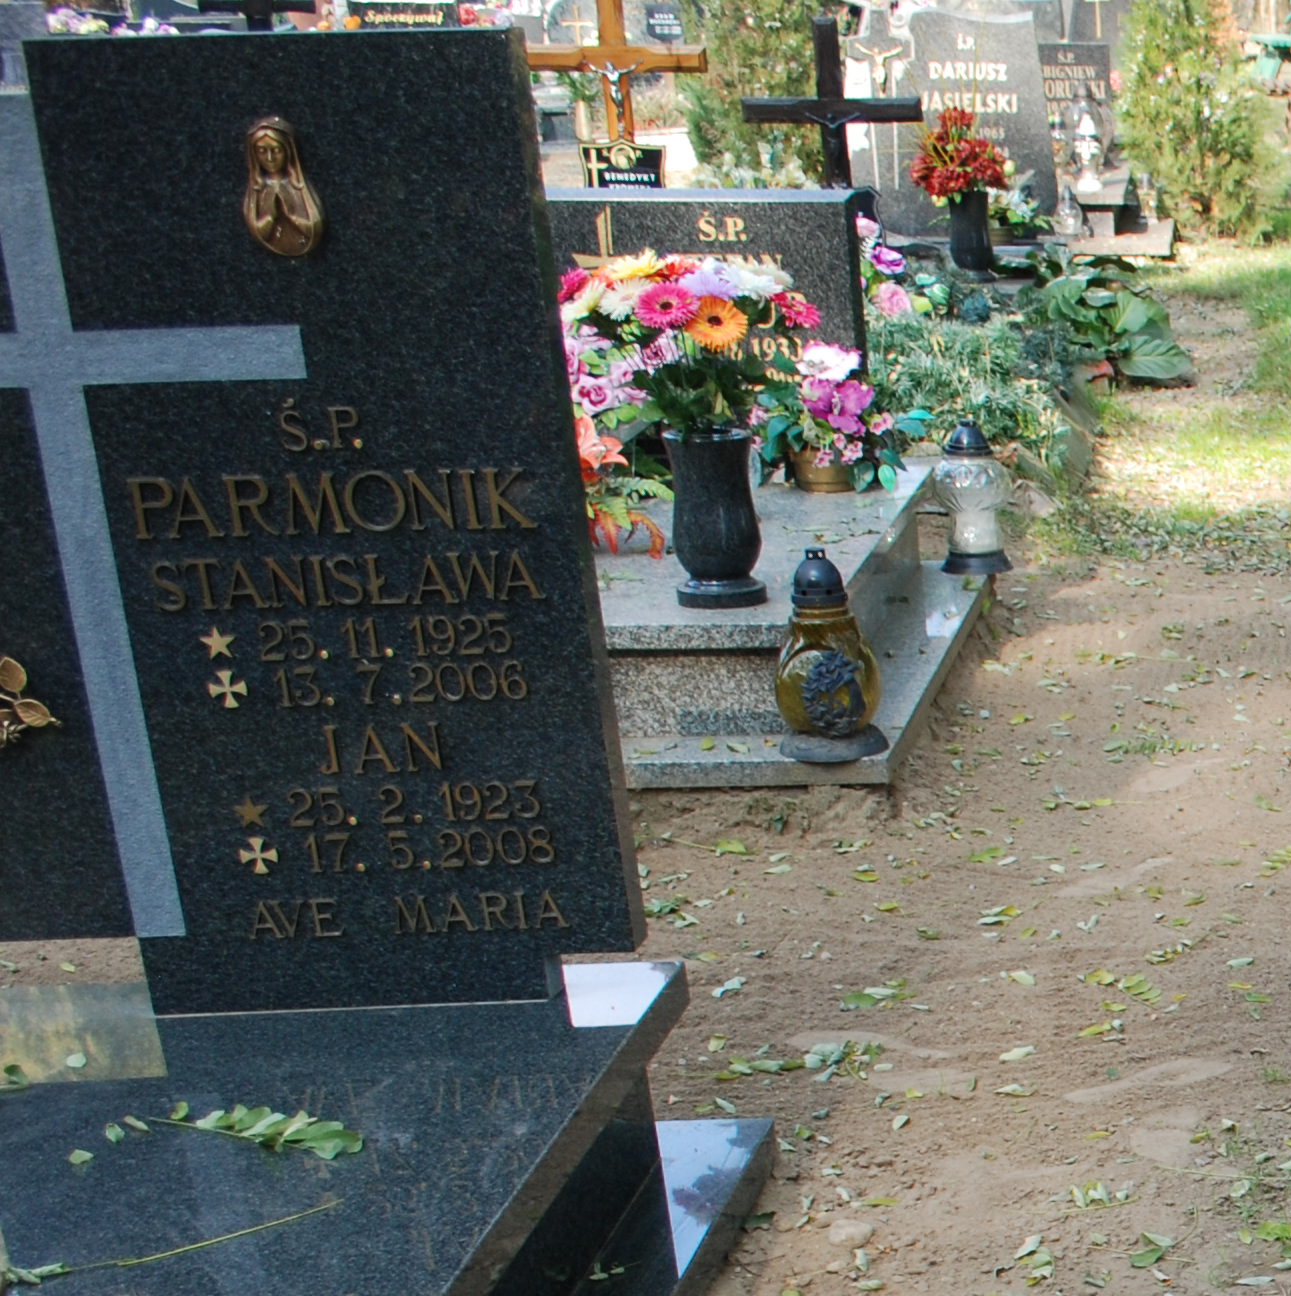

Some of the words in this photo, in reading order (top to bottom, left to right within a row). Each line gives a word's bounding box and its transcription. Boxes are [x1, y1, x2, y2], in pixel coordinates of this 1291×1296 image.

[928, 61, 1008, 81] DARIUSZ
[1041, 65, 1097, 79] BIGNIEW
[126, 466, 539, 540] PARMONIK
[150, 548, 546, 612] STANISŁAWA
[320, 720, 443, 774] JAN
[251, 897, 345, 941] AVE
[394, 889, 570, 935] MARIA
